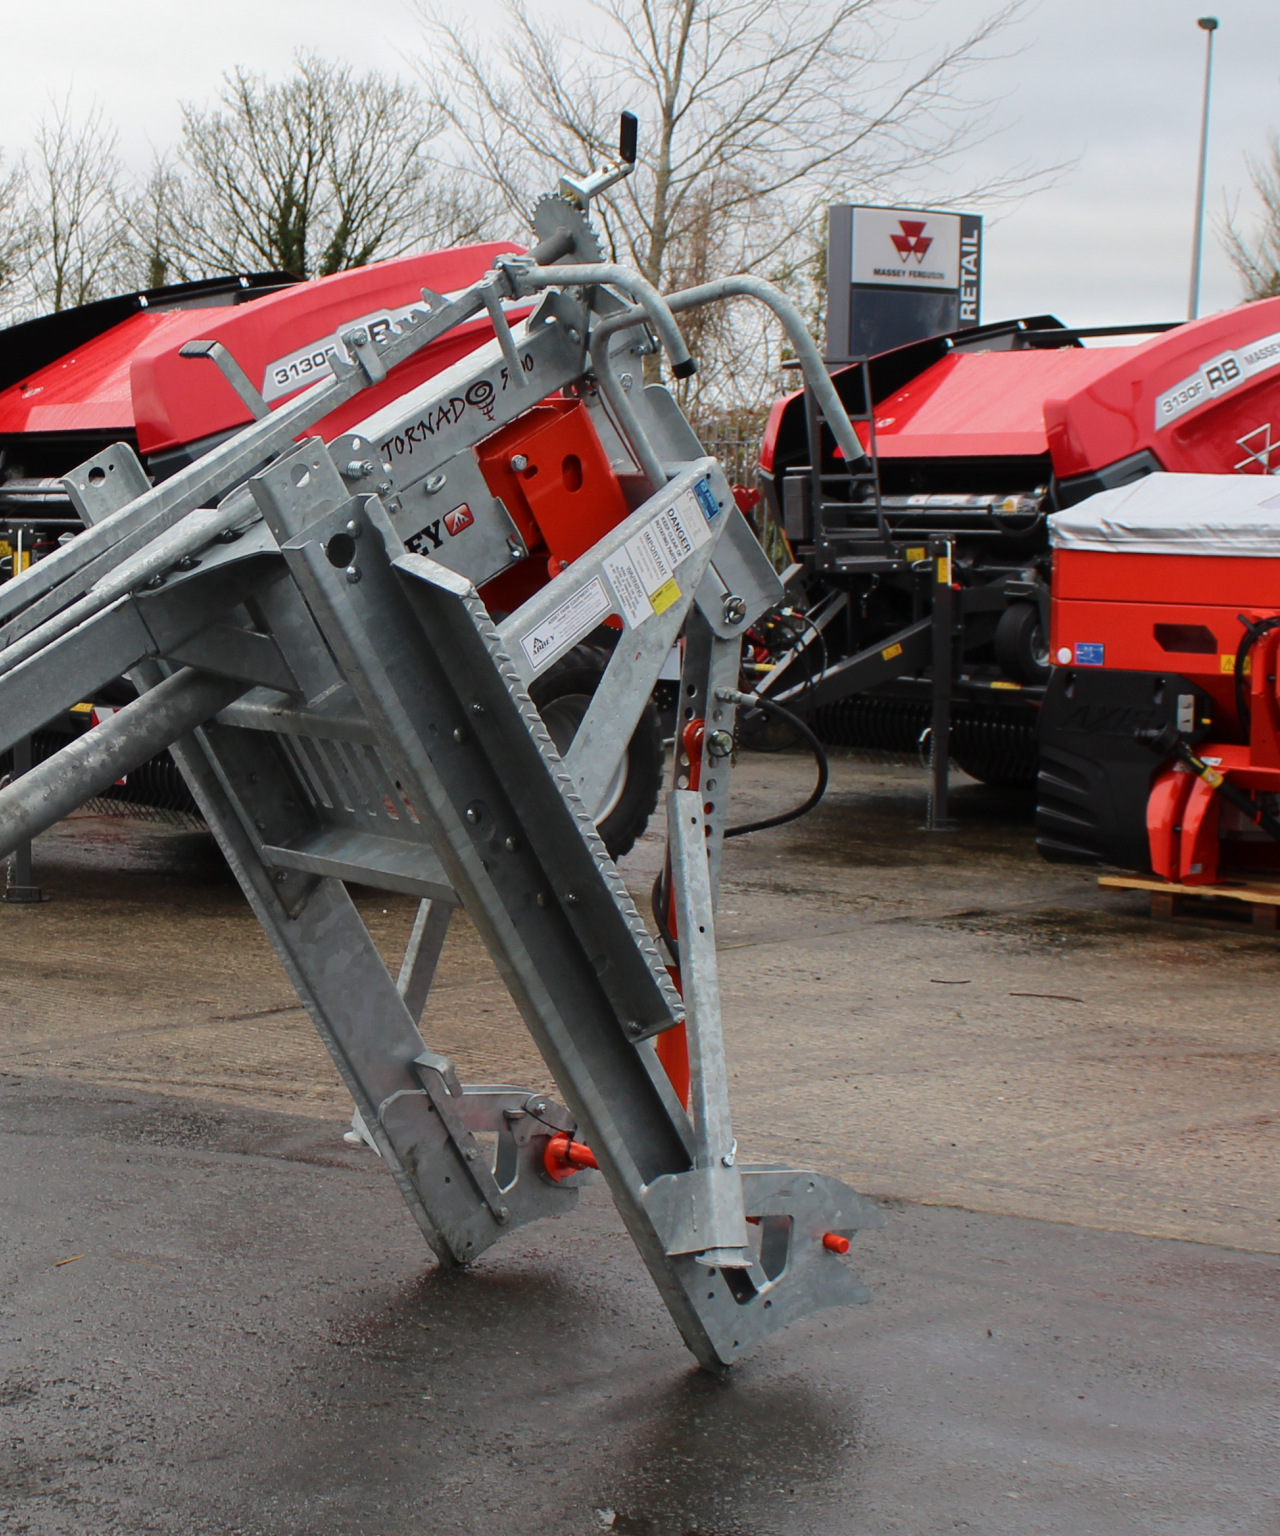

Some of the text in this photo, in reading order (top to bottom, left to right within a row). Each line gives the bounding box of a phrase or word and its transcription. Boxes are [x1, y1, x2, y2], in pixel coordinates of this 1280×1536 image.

[874, 268, 944, 280] MASSEY FERGUSON
[960, 229, 978, 320] RETAIL
[1163, 382, 1203, 413] 3130F
[1206, 358, 1241, 390] RB
[381, 379, 496, 462] TORNADO
[654, 519, 678, 564] ROTATING PARTS
[660, 516, 670, 531] KEEP
[667, 530, 678, 550] CLEAR
[667, 507, 691, 553] DANGER
[643, 530, 668, 576] IMPORTANT
[625, 565, 644, 598] WARNING
[532, 634, 555, 656] ABBEY
